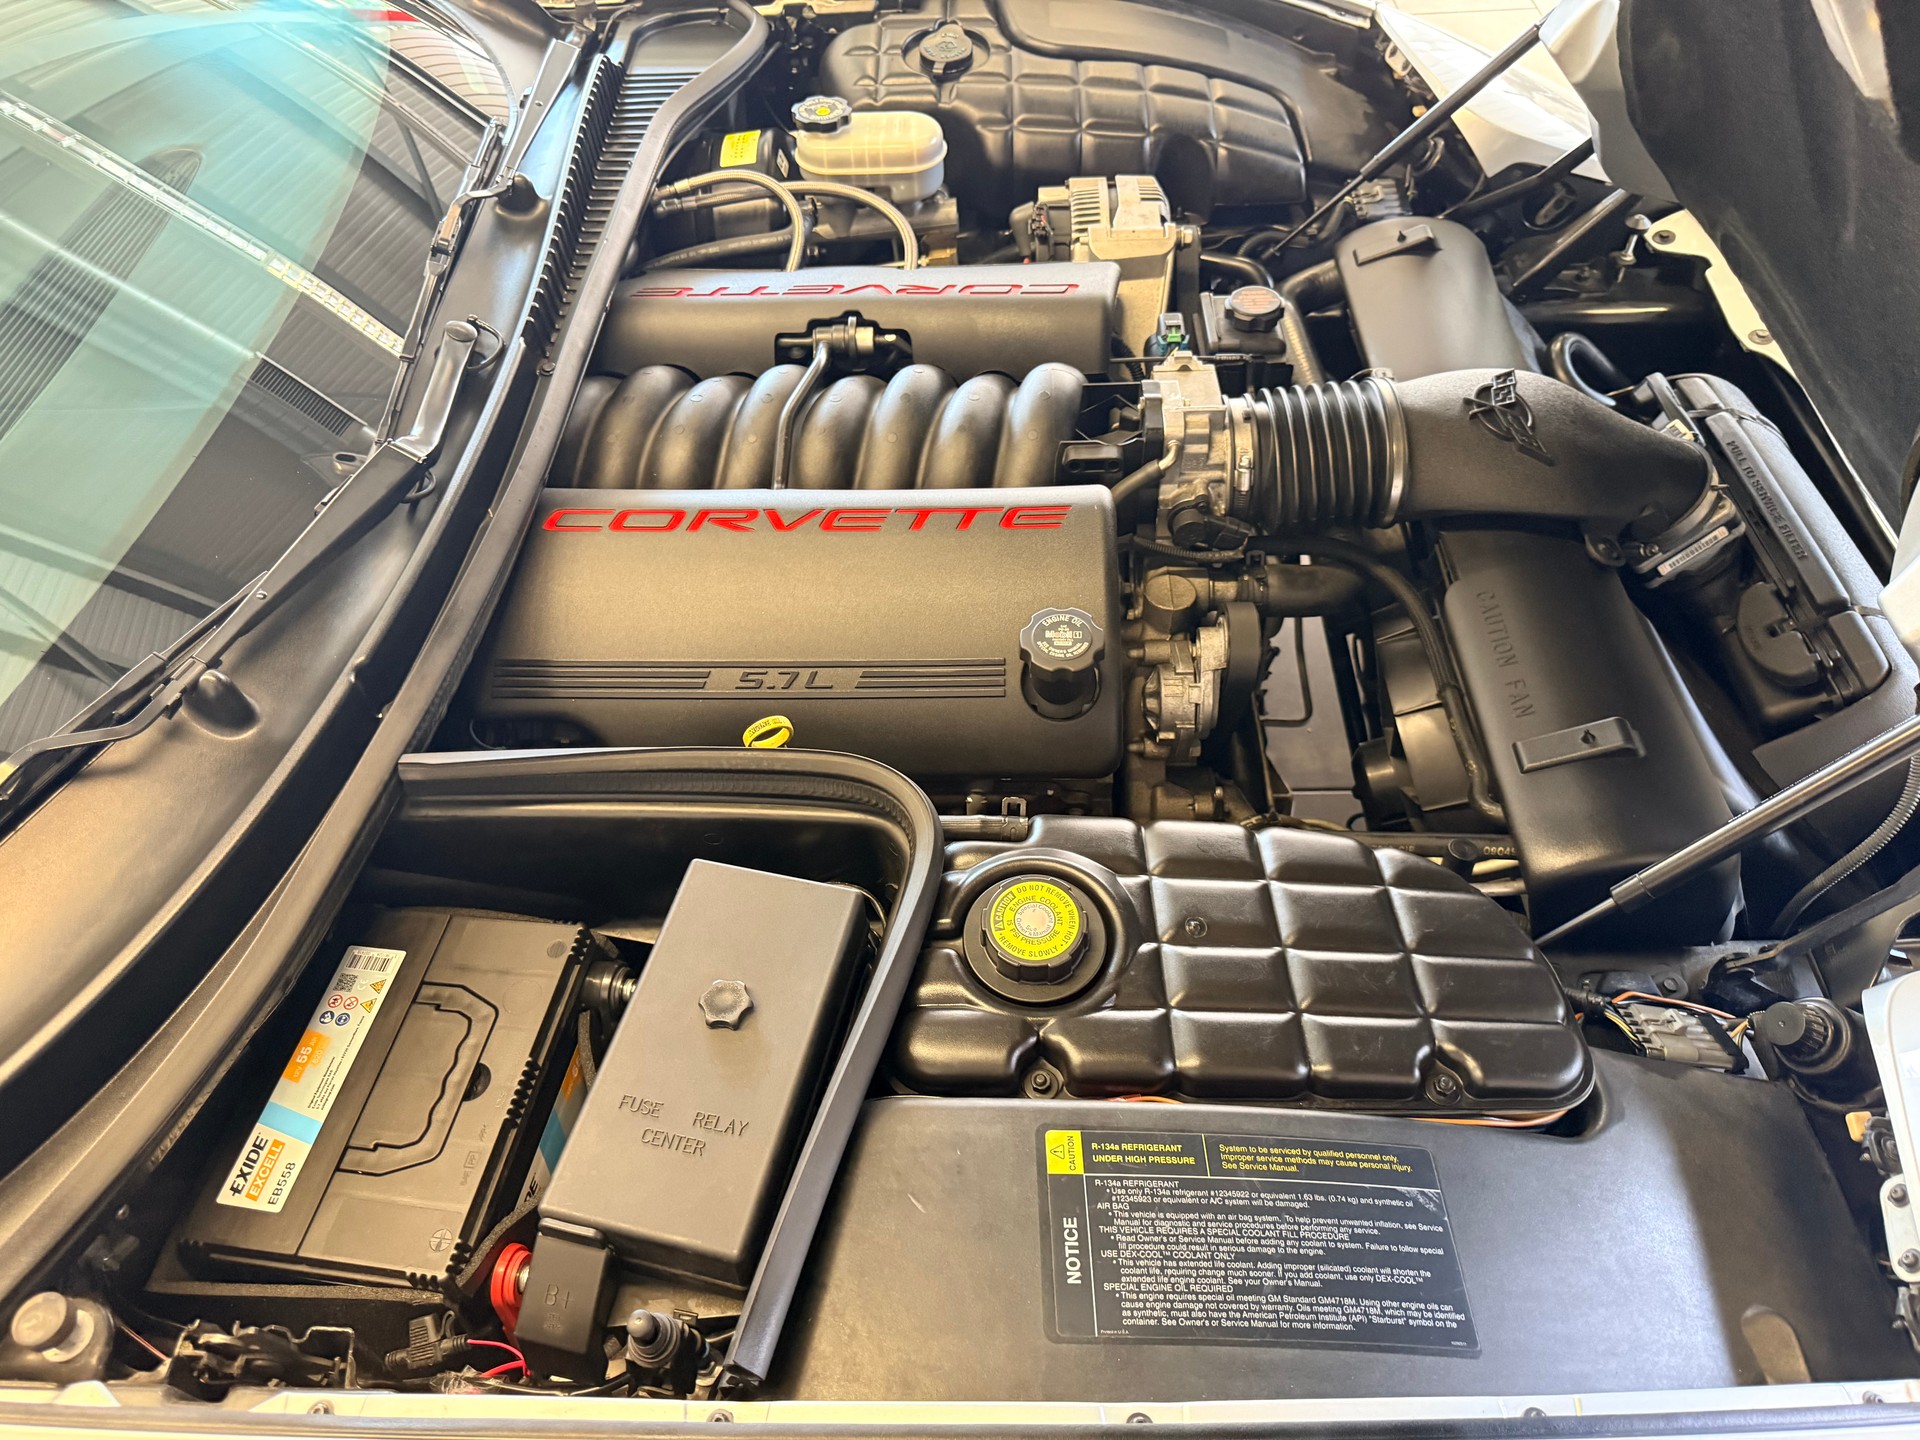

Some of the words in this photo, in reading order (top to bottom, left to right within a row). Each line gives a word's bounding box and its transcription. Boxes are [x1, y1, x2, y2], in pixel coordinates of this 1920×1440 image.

[631, 284, 1079, 297] CORVETTE
[541, 505, 1073, 532] CORVETTE
[1042, 615, 1070, 627] ENGINE
[1071, 616, 1083, 627] OIL
[1476, 591, 1519, 668] CAUTION
[1504, 678, 1536, 719] FAN
[735, 670, 833, 689] 5.7L
[1016, 885, 1027, 894] DO
[1029, 884, 1044, 892] NOT
[1045, 886, 1072, 909] REMOVE
[995, 894, 1014, 921] CAUTION
[1010, 895, 1037, 913] ENGINE
[1039, 896, 1064, 926] COOLANT
[1067, 909, 1077, 930] WHEN
[999, 934, 1026, 956] REMOVE
[1028, 945, 1059, 958] SLOWLY
[1010, 928, 1021, 941] PSI
[1020, 929, 1061, 946] PRESSURE
[1063, 930, 1074, 944] HOT
[296, 1046, 312, 1064] 55
[618, 1094, 664, 1118] FUSE
[692, 1111, 750, 1137] RELAY
[641, 1128, 706, 1156] CENTER
[1067, 1135, 1077, 1171] CAUTION
[229, 1135, 269, 1197] EXIDE
[1220, 1153, 1254, 1161] Improper
[1358, 1161, 1390, 1169] personal
[1312, 1150, 1344, 1158] qualified
[1344, 1152, 1381, 1160] personnel
[249, 1144, 283, 1197] EXCELL
[267, 1162, 296, 1205] EB558
[1063, 1217, 1082, 1285] NOTICE
[1401, 1301, 1425, 1309] engine
[1408, 1318, 1434, 1326] symbol
